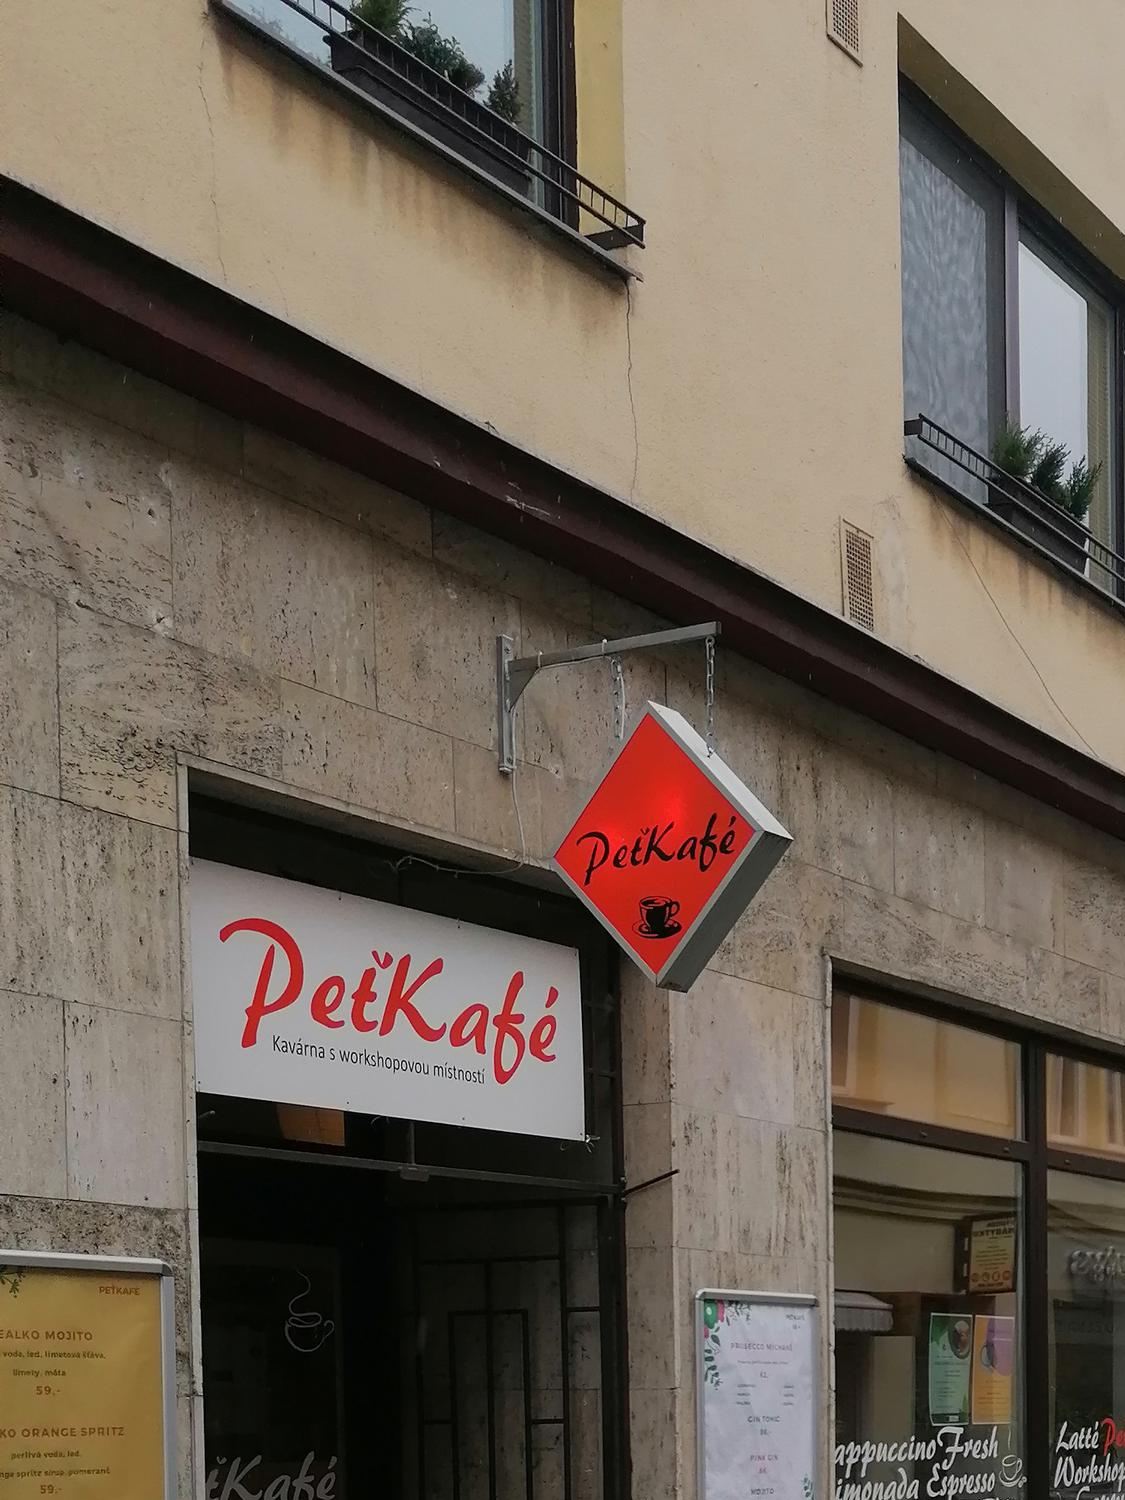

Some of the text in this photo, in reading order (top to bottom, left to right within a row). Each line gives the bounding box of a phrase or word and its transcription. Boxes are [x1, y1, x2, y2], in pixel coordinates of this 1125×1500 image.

[219, 917, 558, 1085] PeťKafé
[272, 1035, 485, 1084] Kavárna s workshopovou místností
[0, 1329, 93, 1341] EALKO MOJITO
[21, 1427, 77, 1438] ORANGE
[80, 1426, 125, 1437] SPRITZ
[835, 1426, 998, 1478] appuccino Fresh
[1056, 1421, 1099, 1453] Latté
